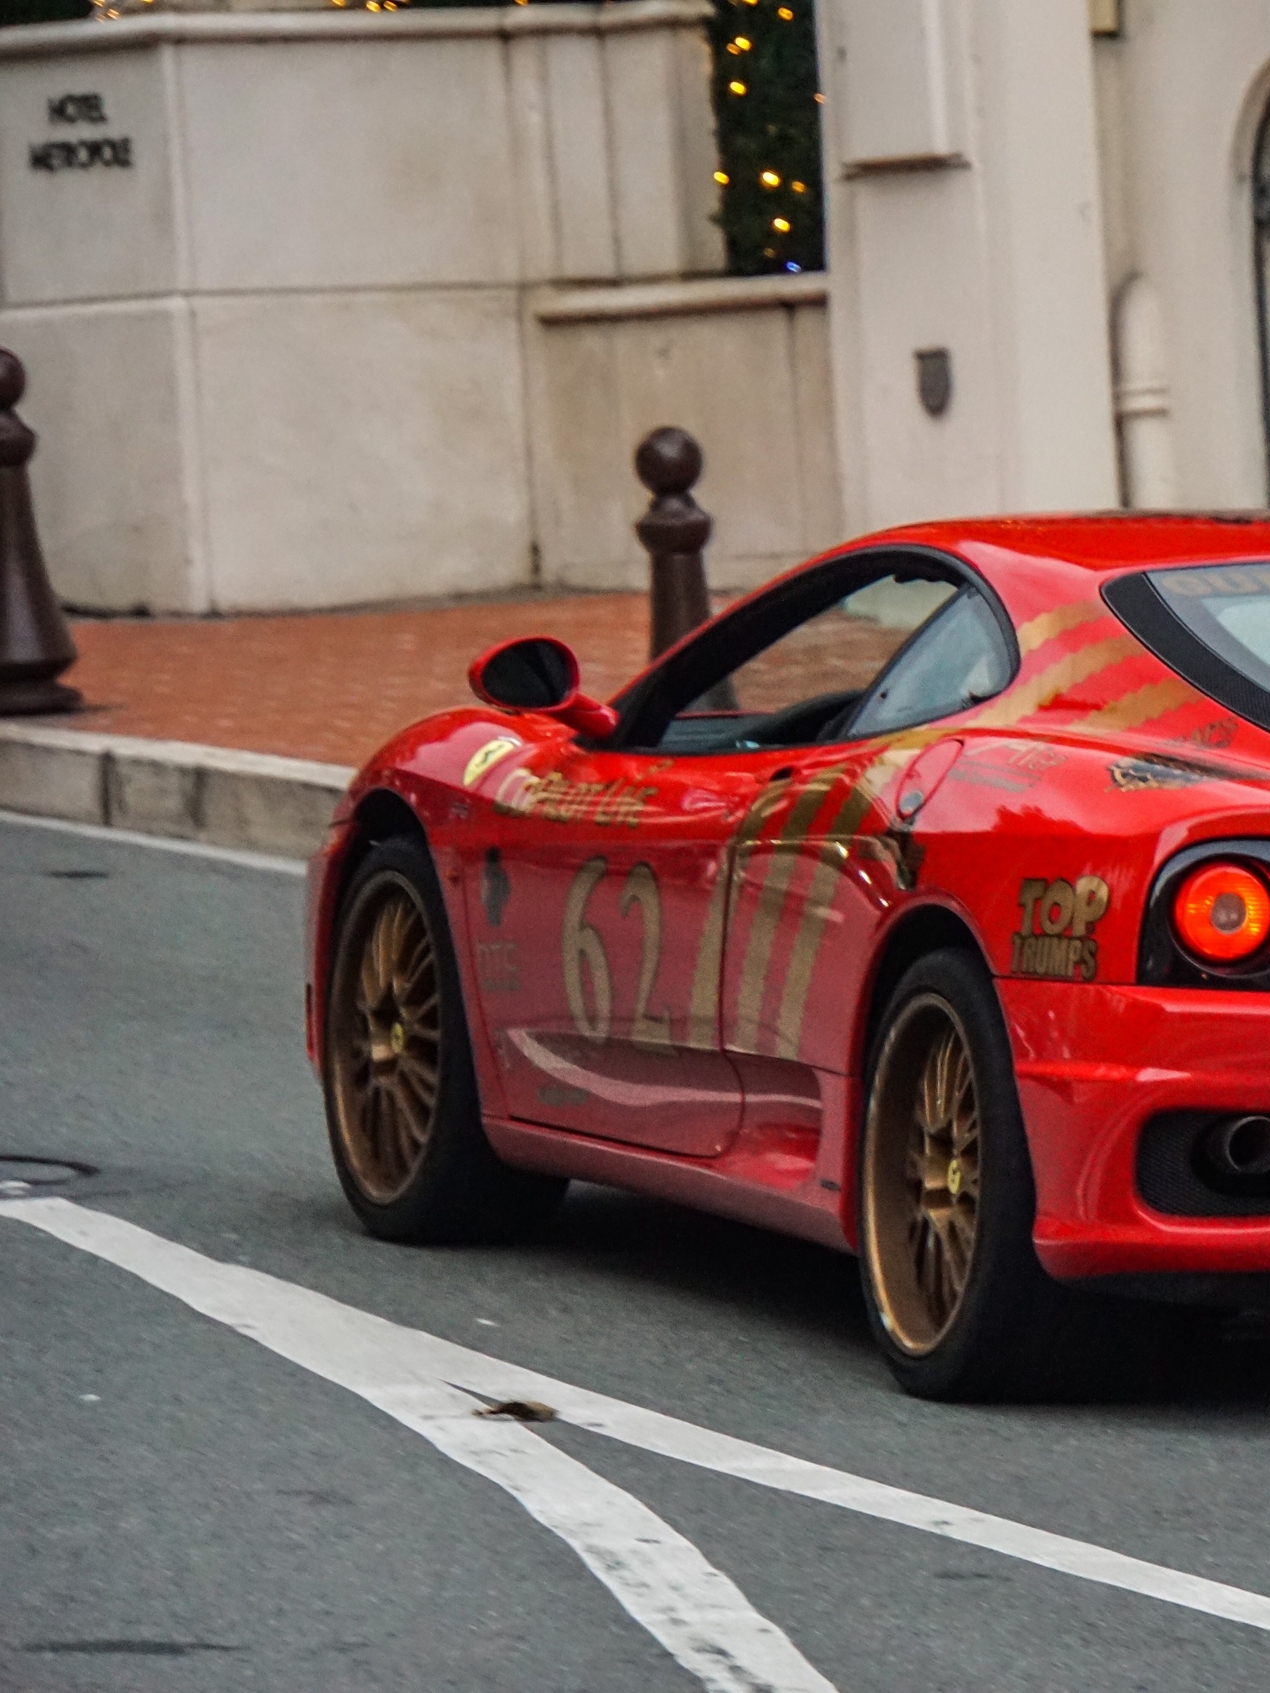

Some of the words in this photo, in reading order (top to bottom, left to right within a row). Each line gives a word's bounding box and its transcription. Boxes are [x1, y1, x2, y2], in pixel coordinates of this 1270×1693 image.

[48, 92, 107, 123] HOTEL
[29, 137, 132, 171] METROPOLE
[1019, 875, 1110, 937] TOP
[560, 854, 678, 1057] 62
[1011, 932, 1098, 981] TRUMPS
